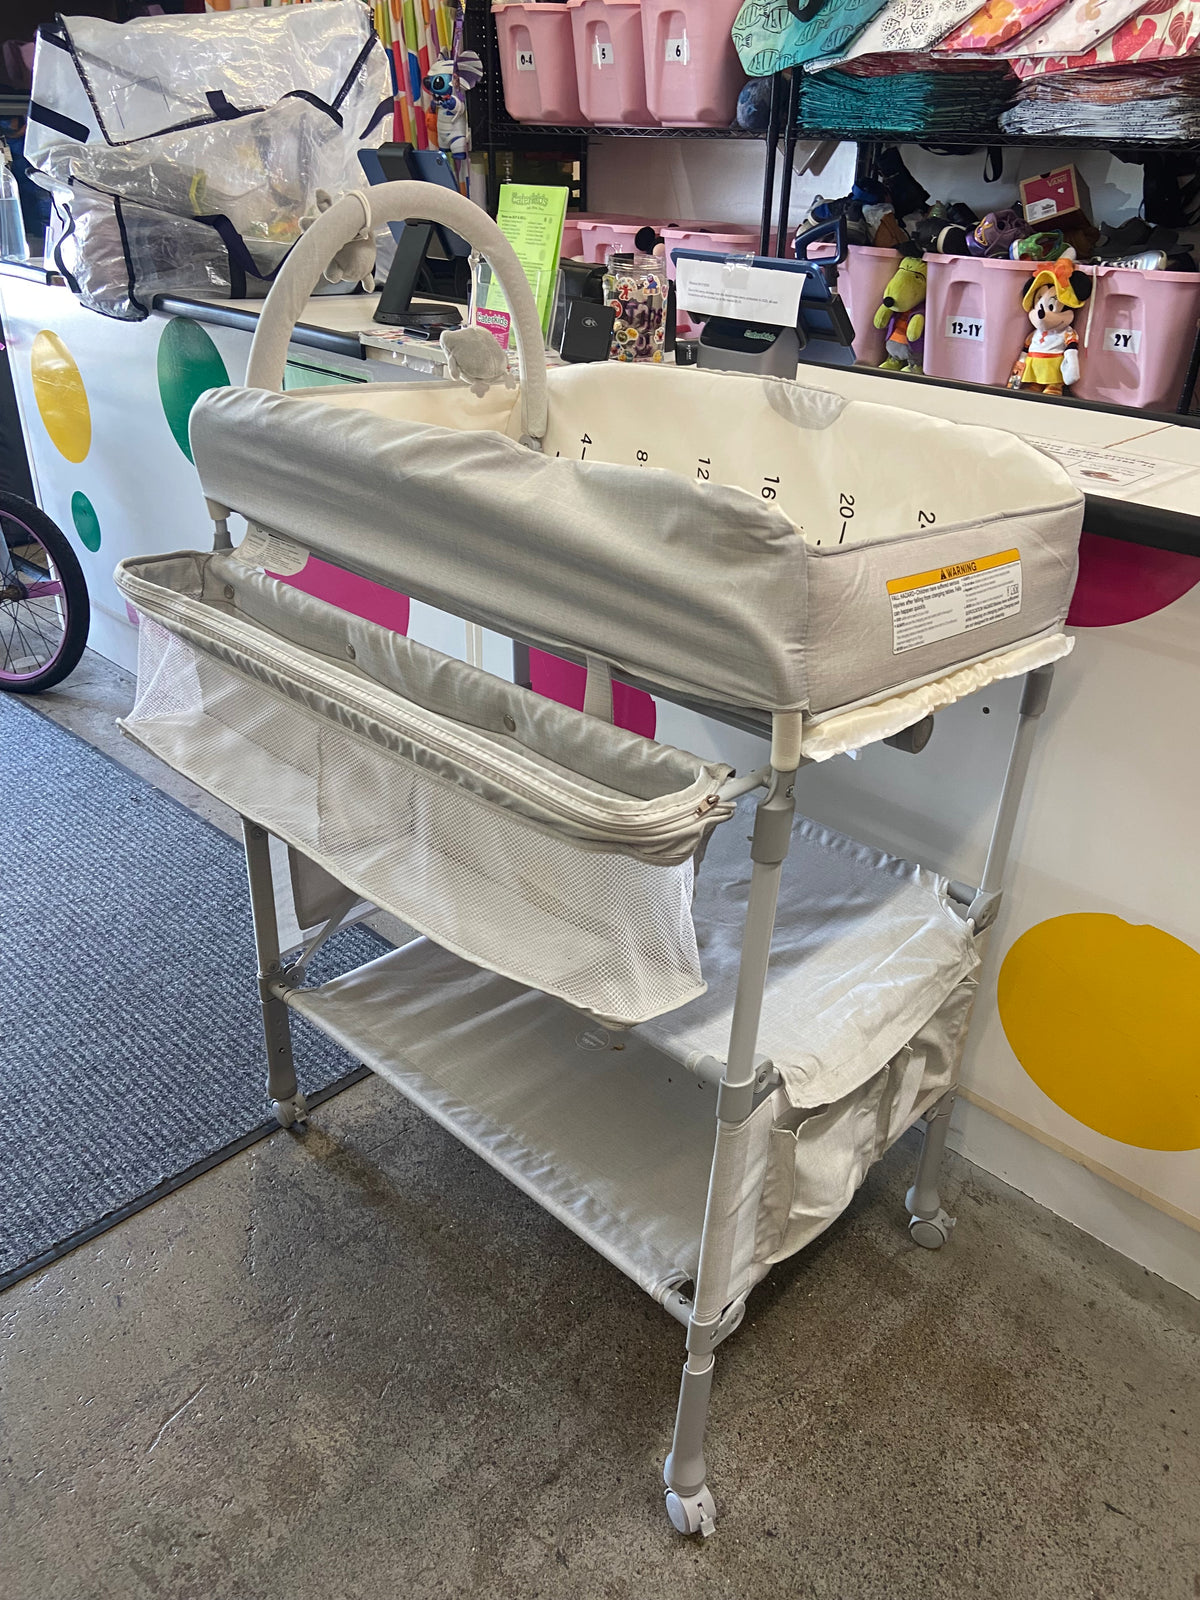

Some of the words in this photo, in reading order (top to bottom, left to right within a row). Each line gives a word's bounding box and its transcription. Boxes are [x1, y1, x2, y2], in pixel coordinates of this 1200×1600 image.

[601, 47, 606, 60] 5
[675, 44, 682, 57] 6
[1046, 173, 1068, 187] VANS
[951, 321, 982, 337] 13-1Y
[1113, 333, 1132, 348] 2Y
[580, 433, 593, 445] 4
[636, 449, 649, 462] 8
[697, 457, 711, 480] 12
[761, 476, 780, 500] 16
[839, 492, 855, 519] 20
[918, 510, 936, 528] 2
[946, 561, 977, 578] WARNING
